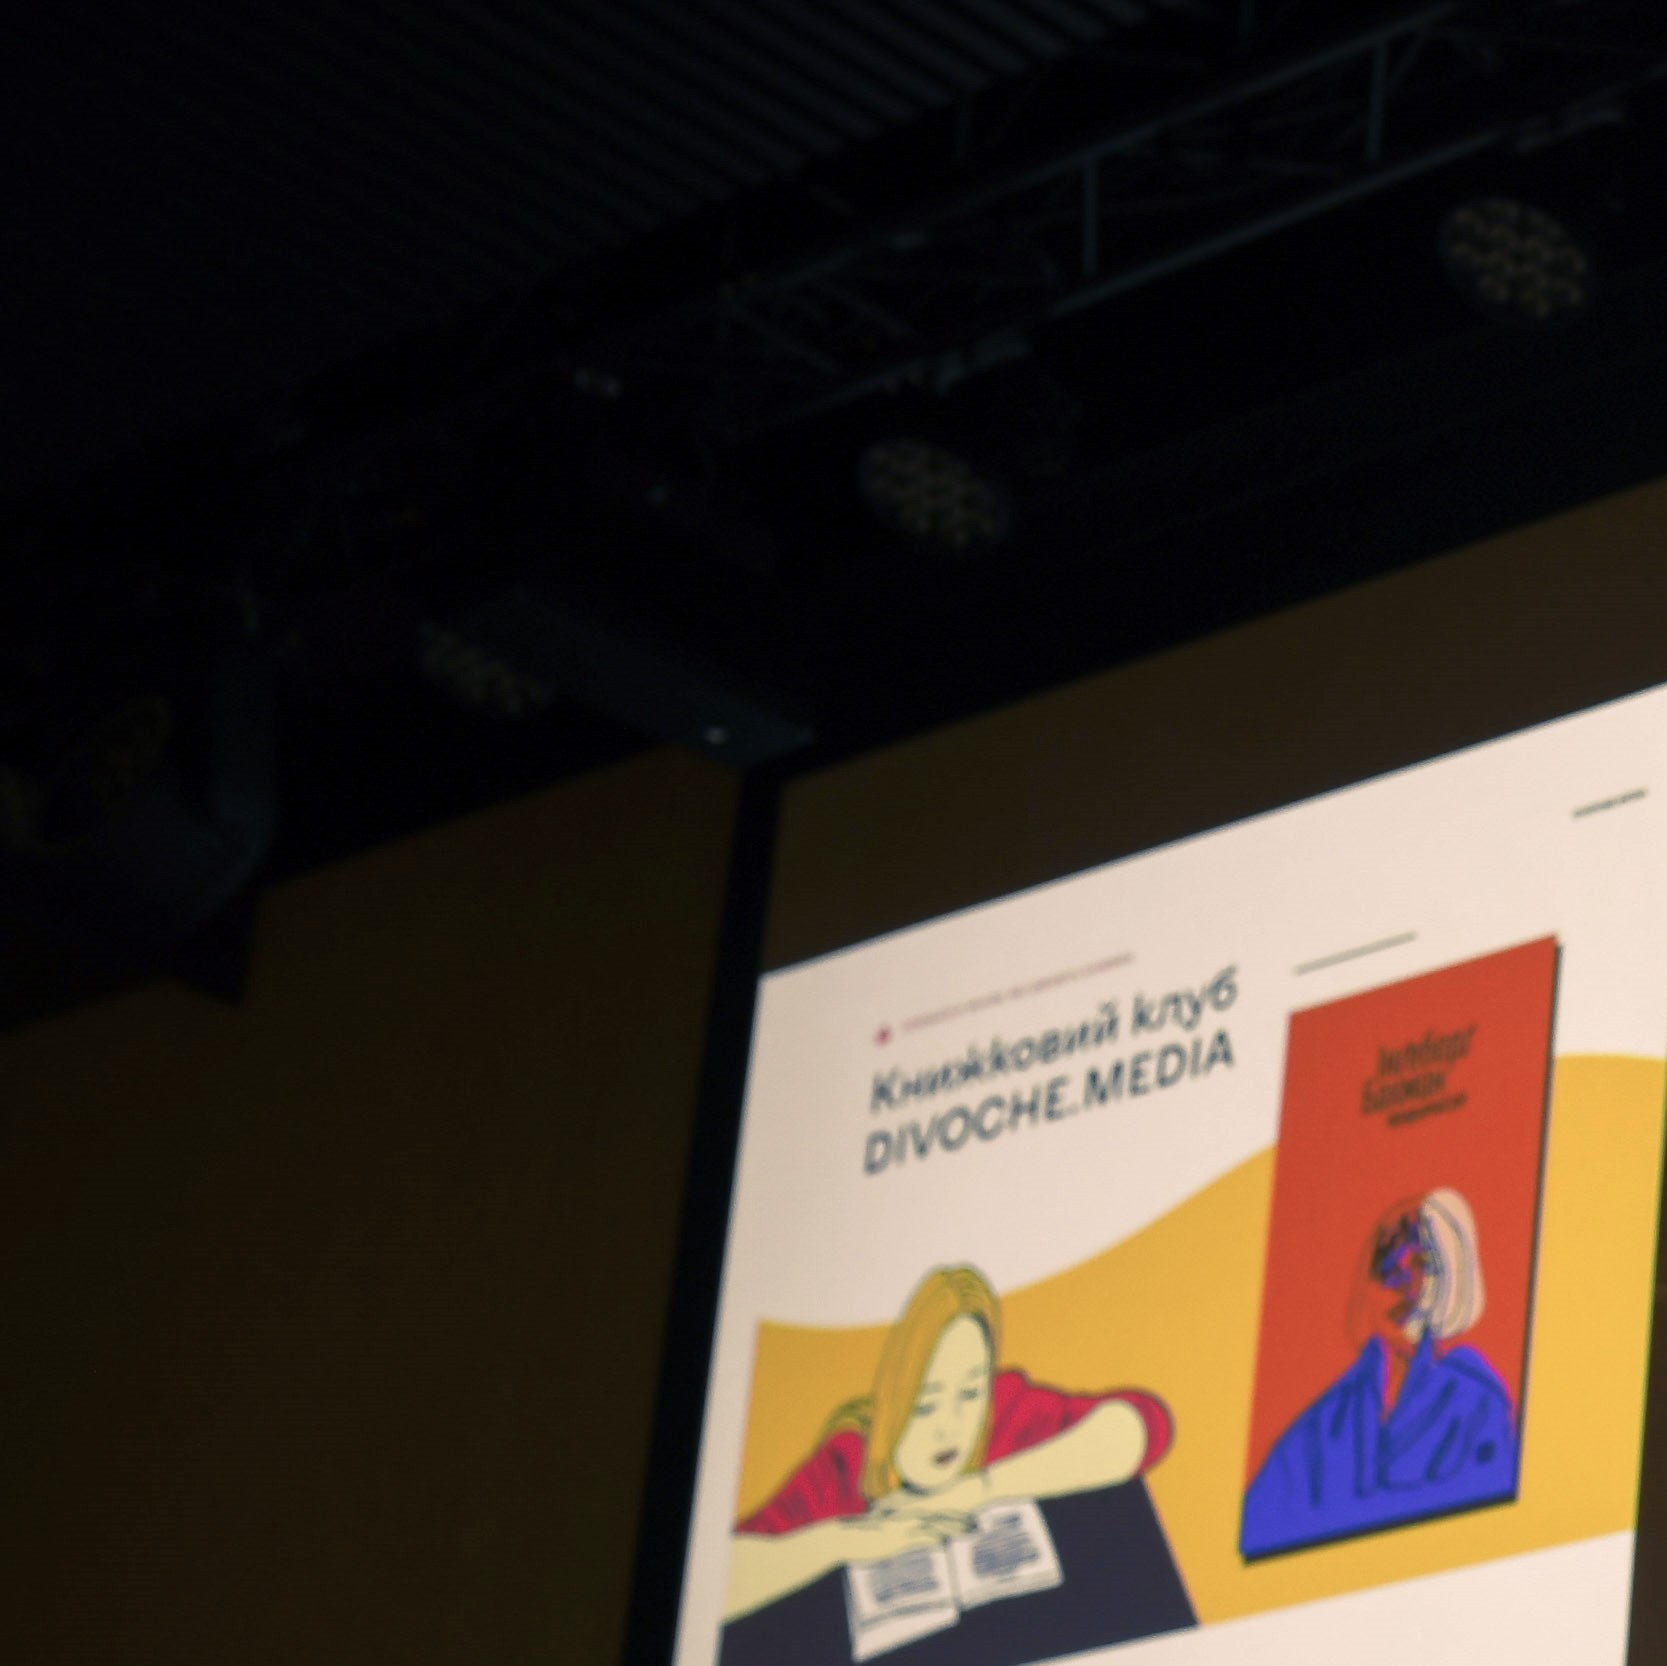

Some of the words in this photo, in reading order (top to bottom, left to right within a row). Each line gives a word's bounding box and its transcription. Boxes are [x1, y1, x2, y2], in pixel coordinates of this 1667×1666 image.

[863, 1027, 1234, 1176] DIVOCHE.MEDIA
[870, 1000, 1119, 1113] Книжковий
[1131, 962, 1239, 1037] клуб
